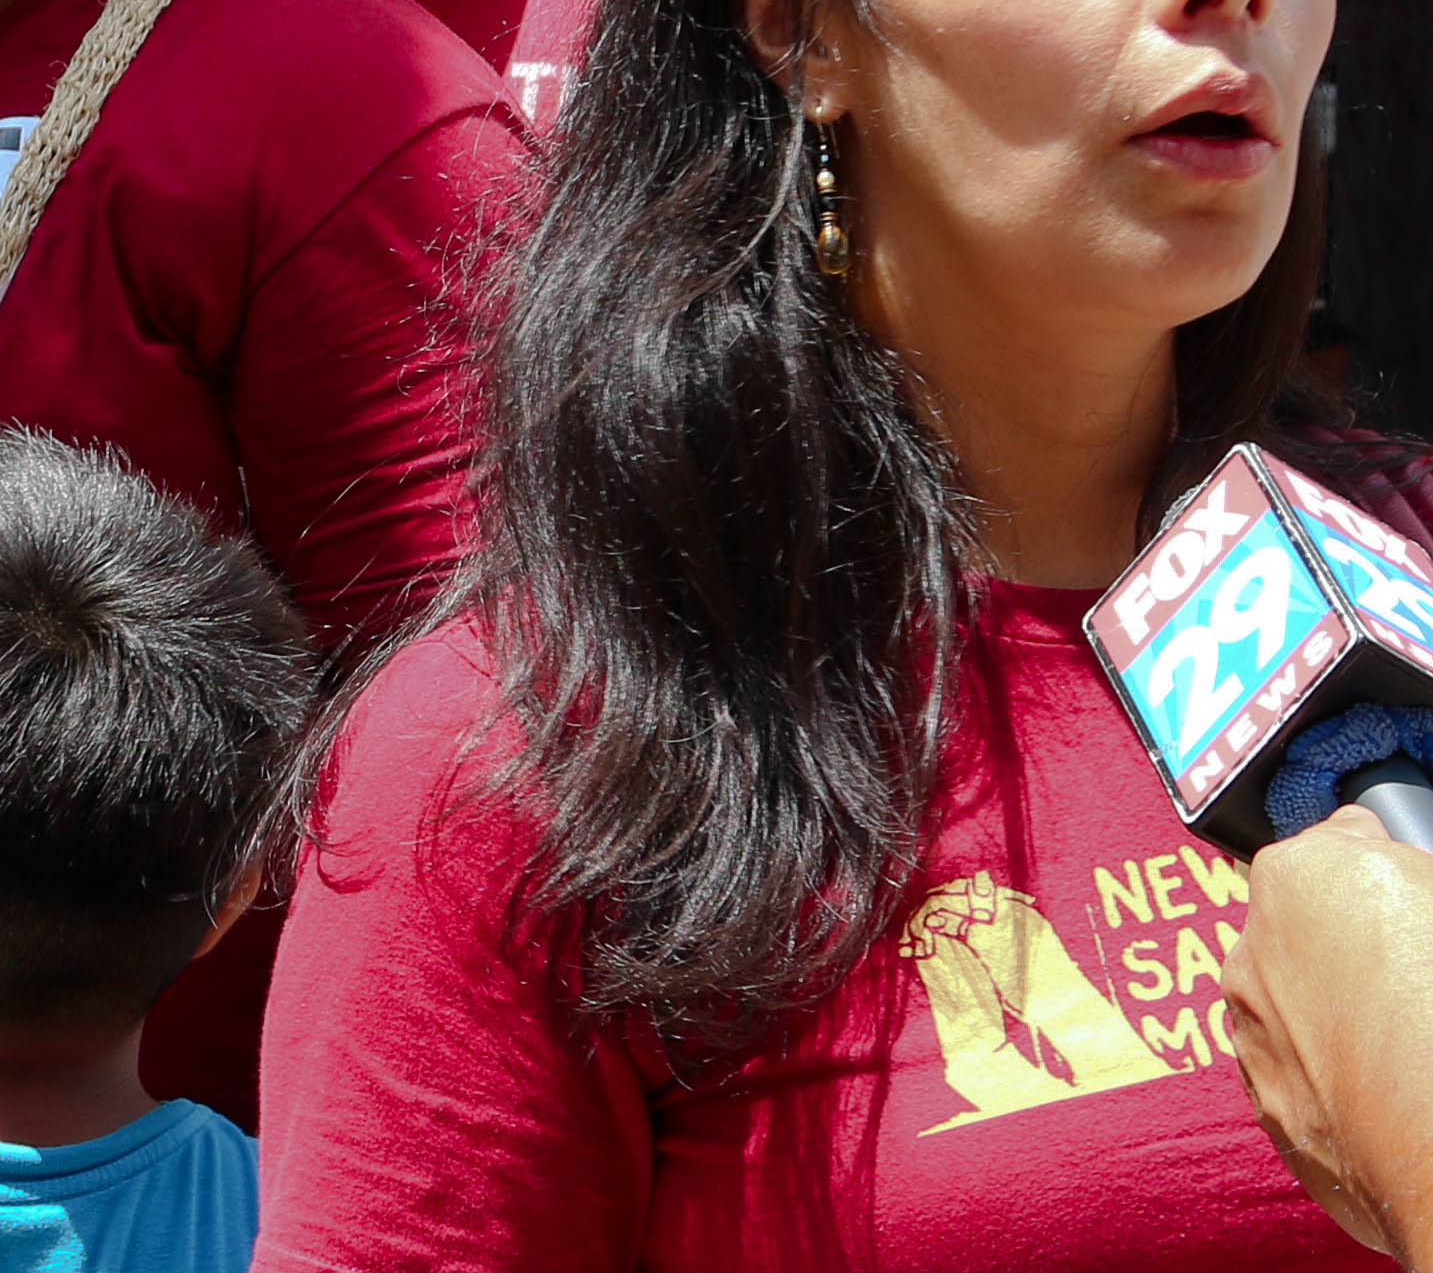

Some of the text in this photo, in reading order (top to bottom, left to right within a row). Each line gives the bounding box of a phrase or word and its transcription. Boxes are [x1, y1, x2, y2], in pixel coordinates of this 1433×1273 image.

[1113, 479, 1251, 646] FOX
[1286, 470, 1432, 584] FOX
[1148, 546, 1291, 759] 29
[1189, 631, 1333, 793] NEWS
